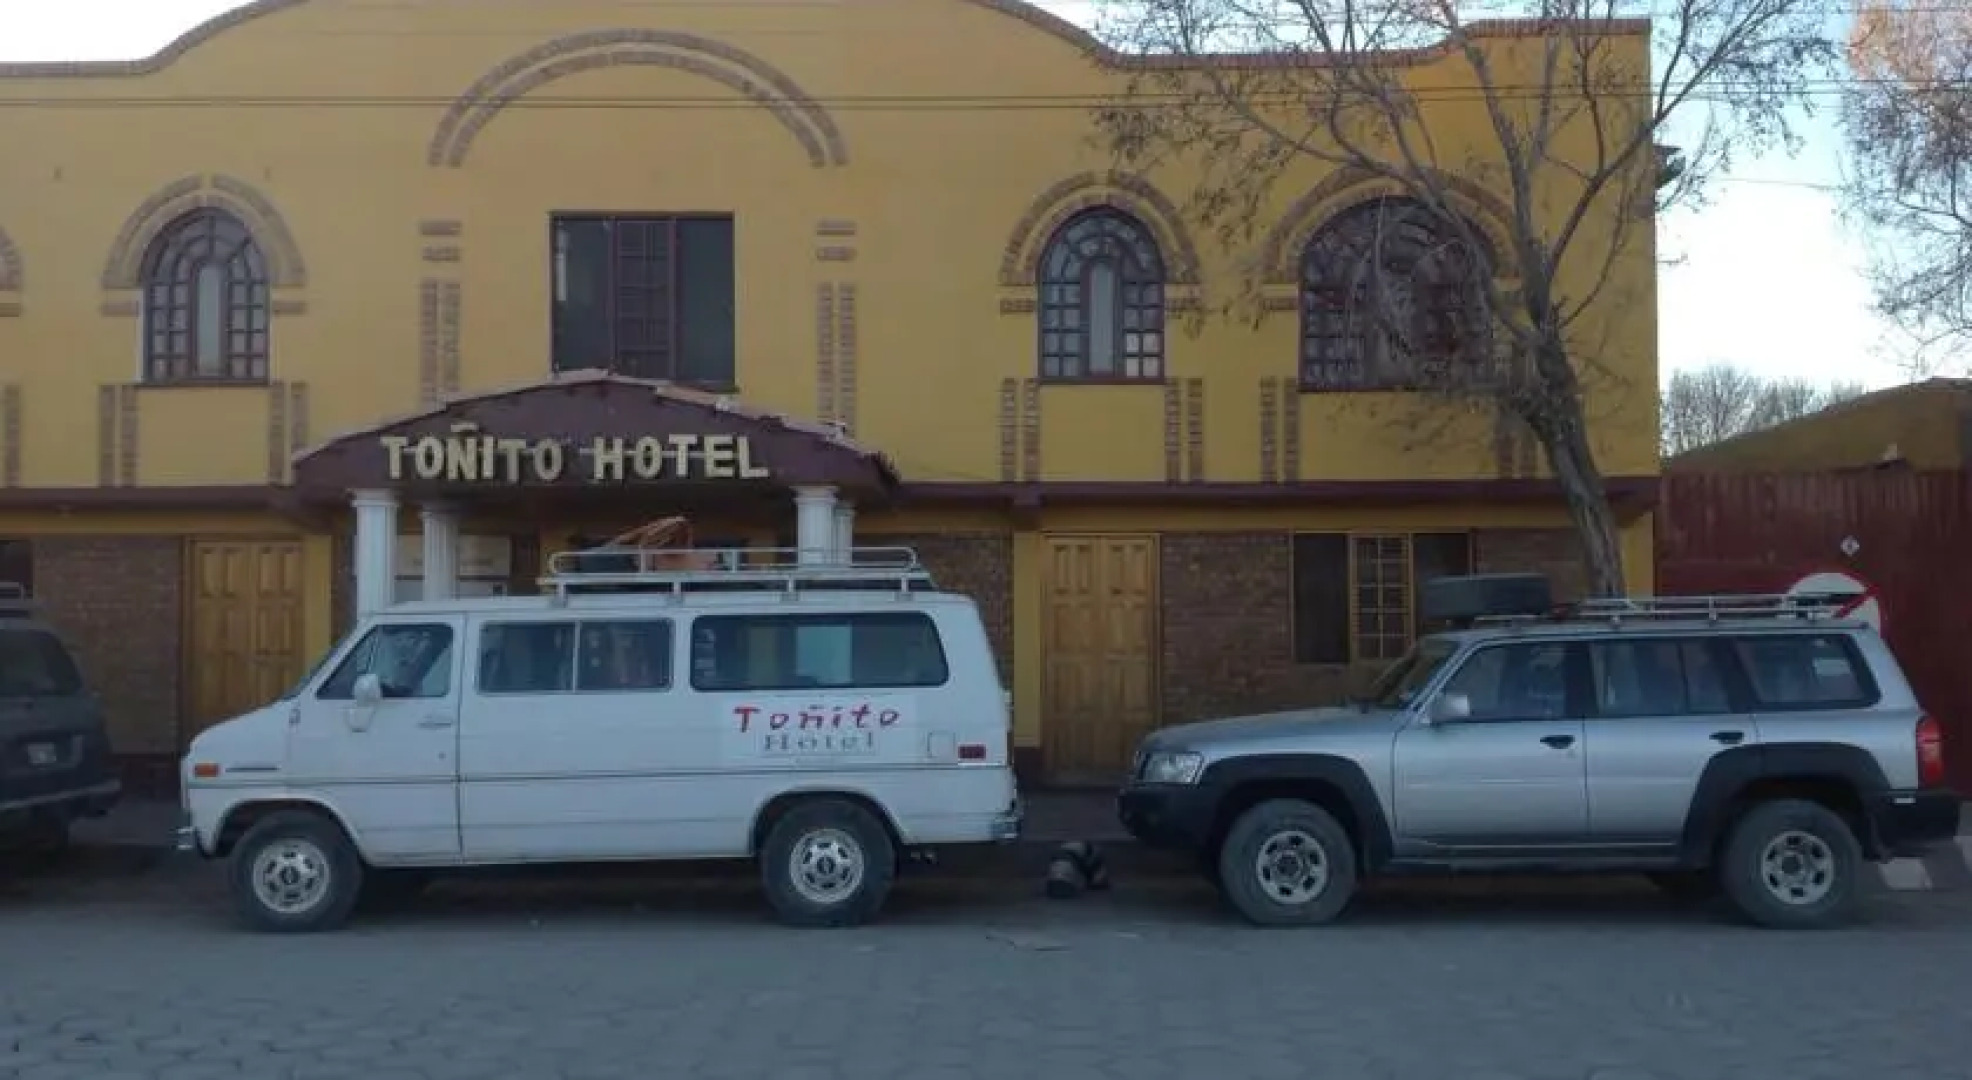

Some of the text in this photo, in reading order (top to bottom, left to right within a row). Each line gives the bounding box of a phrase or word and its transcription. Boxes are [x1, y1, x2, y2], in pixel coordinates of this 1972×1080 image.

[381, 422, 769, 483] TOÑITO HOTEL
[733, 703, 901, 733] Toñito
[764, 732, 874, 752] Hotel
